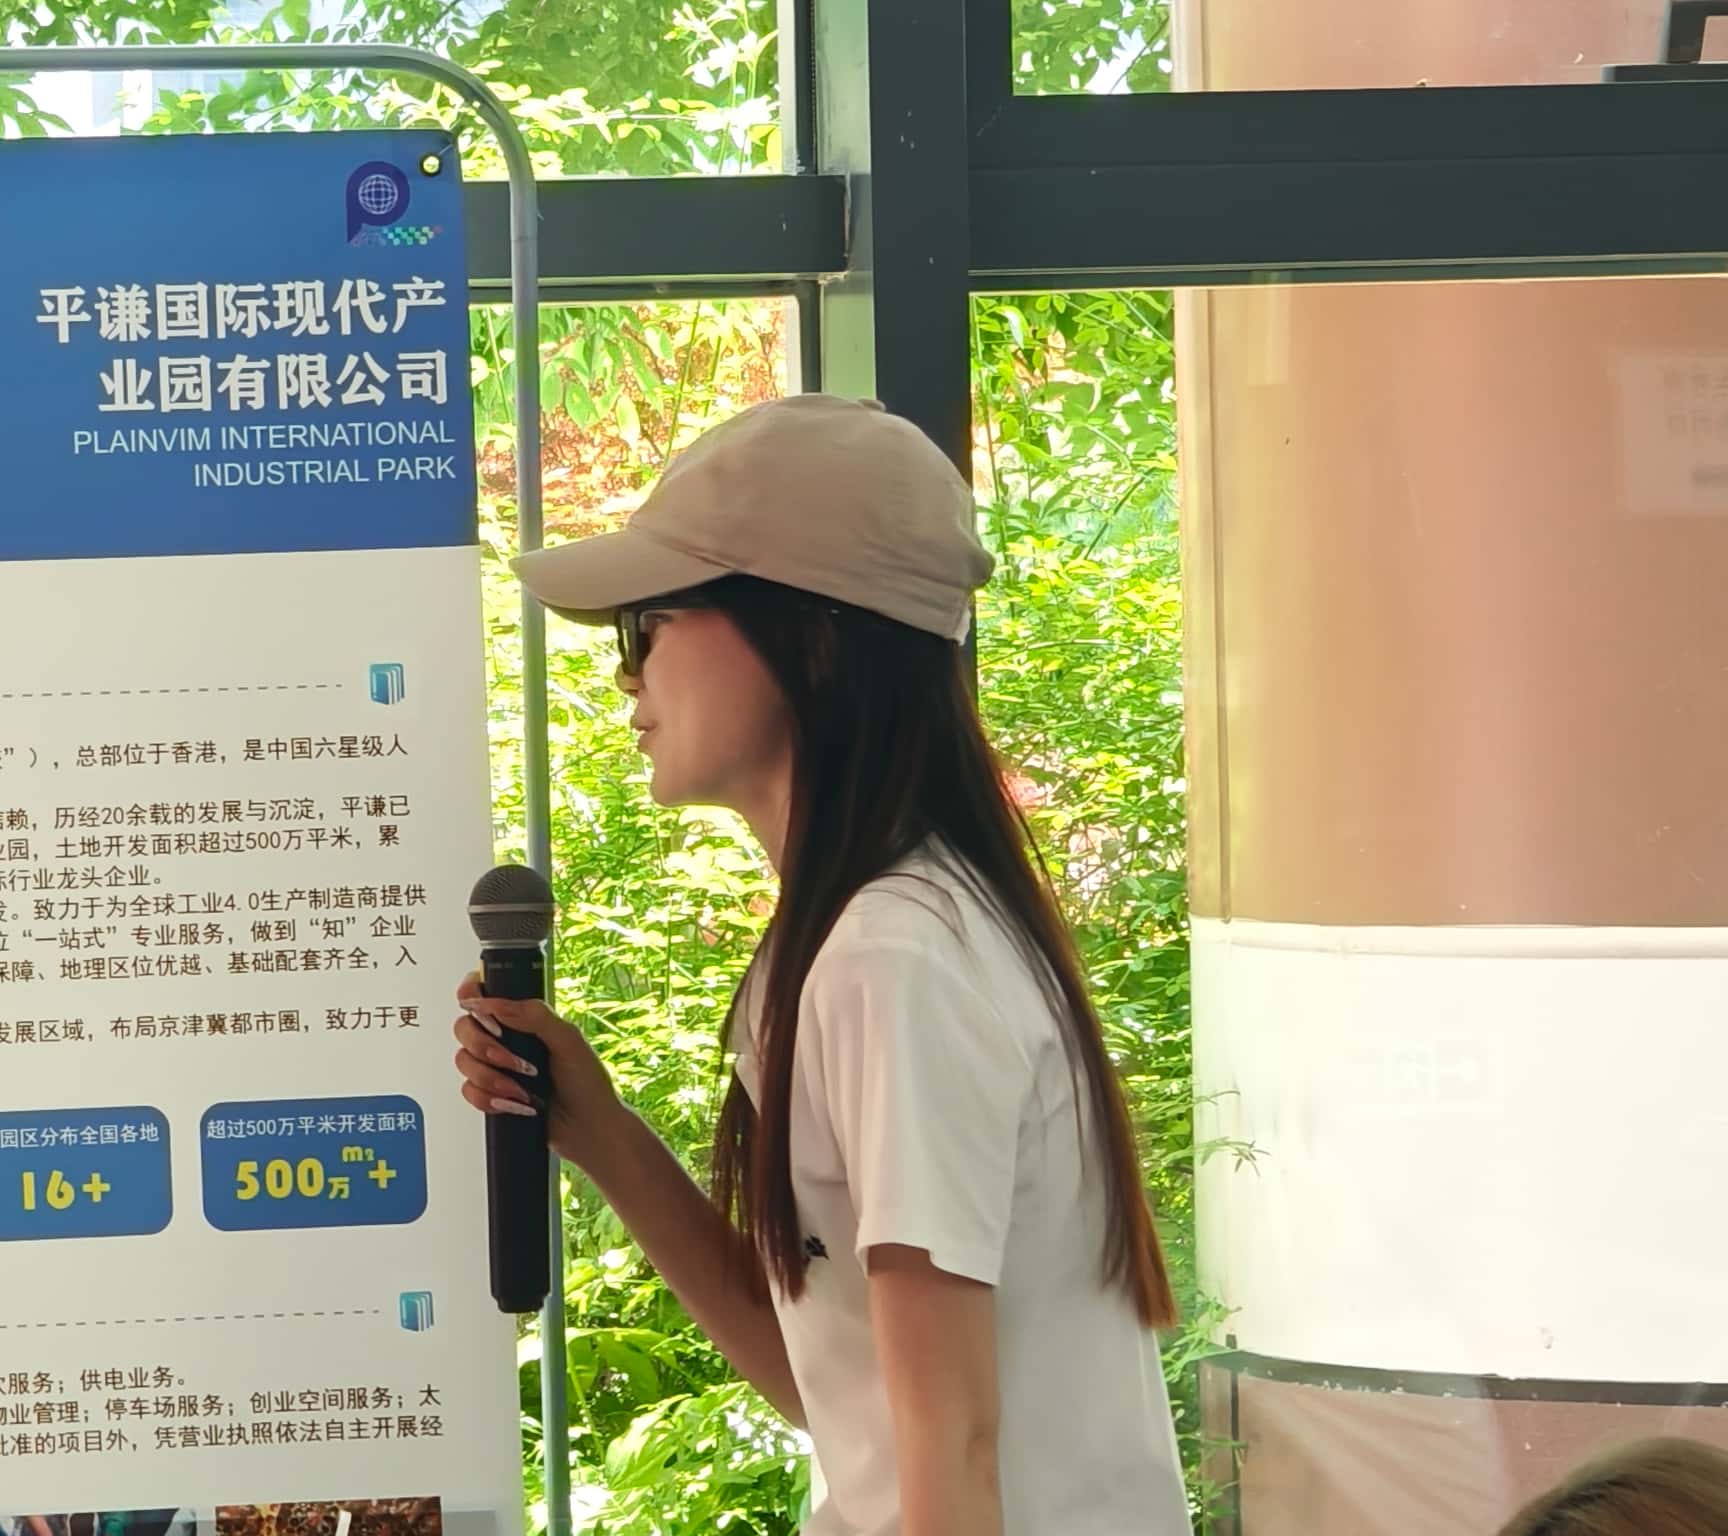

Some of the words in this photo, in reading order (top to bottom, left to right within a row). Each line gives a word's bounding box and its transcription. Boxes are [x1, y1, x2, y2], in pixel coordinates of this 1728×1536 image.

[35, 275, 447, 344] 平谦国际现代产
[97, 350, 449, 413] 业园有限公司
[73, 427, 212, 455] PLAINVIM
[220, 421, 456, 450] INTERNATIONAL
[193, 459, 370, 487] INDUSTRIAL
[377, 456, 457, 481] PARK
[207, 1112, 417, 1139] 超过500万平米开发面积
[22, 1169, 112, 1211] 16+
